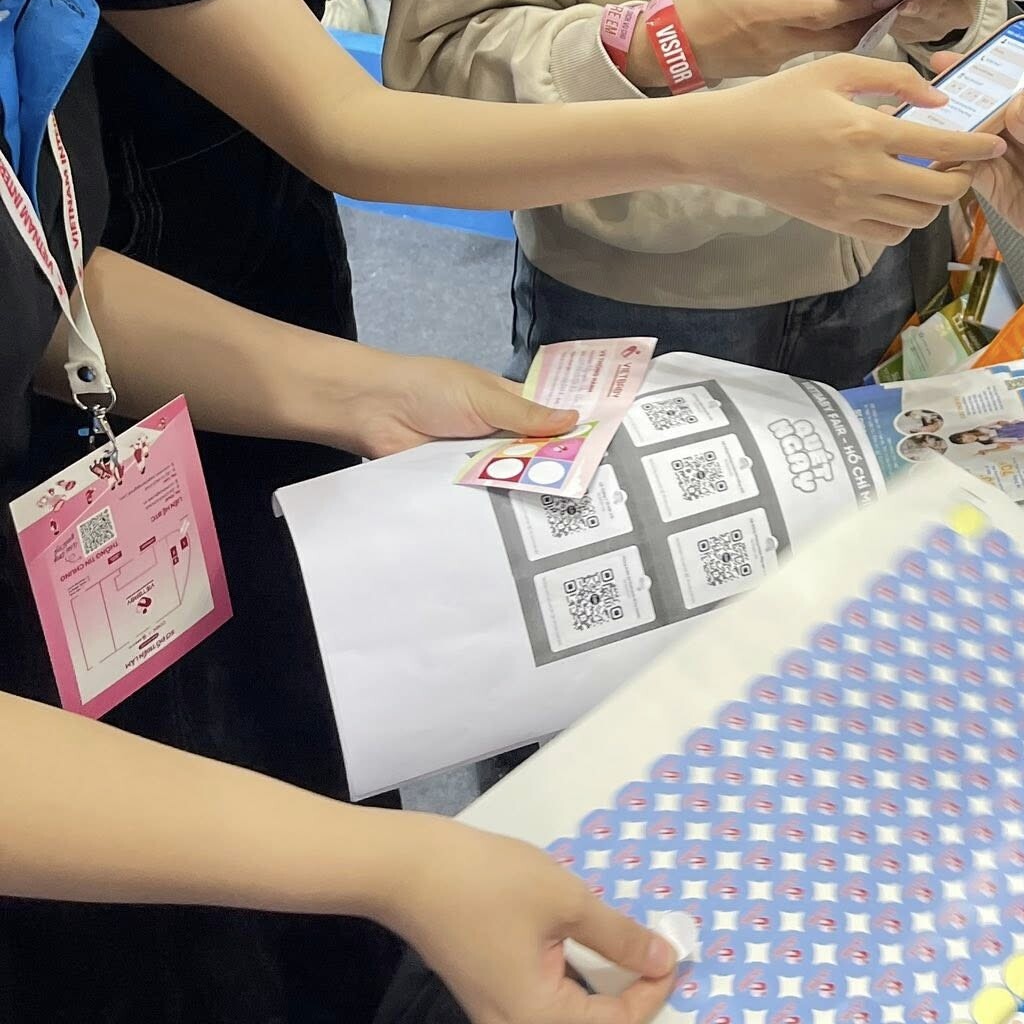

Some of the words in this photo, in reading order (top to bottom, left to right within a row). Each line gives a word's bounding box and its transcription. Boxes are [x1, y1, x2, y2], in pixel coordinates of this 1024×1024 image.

[656, 24, 692, 83] VISITOR
[63, 169, 79, 249] VIETNAM
[20, 205, 54, 275] VIETNAM
[793, 419, 834, 481] QUÉT
[828, 413, 847, 435] FAIR
[768, 418, 817, 493] NGAY
[58, 563, 85, 582] CHUNG
[84, 556, 96, 566] TIN
